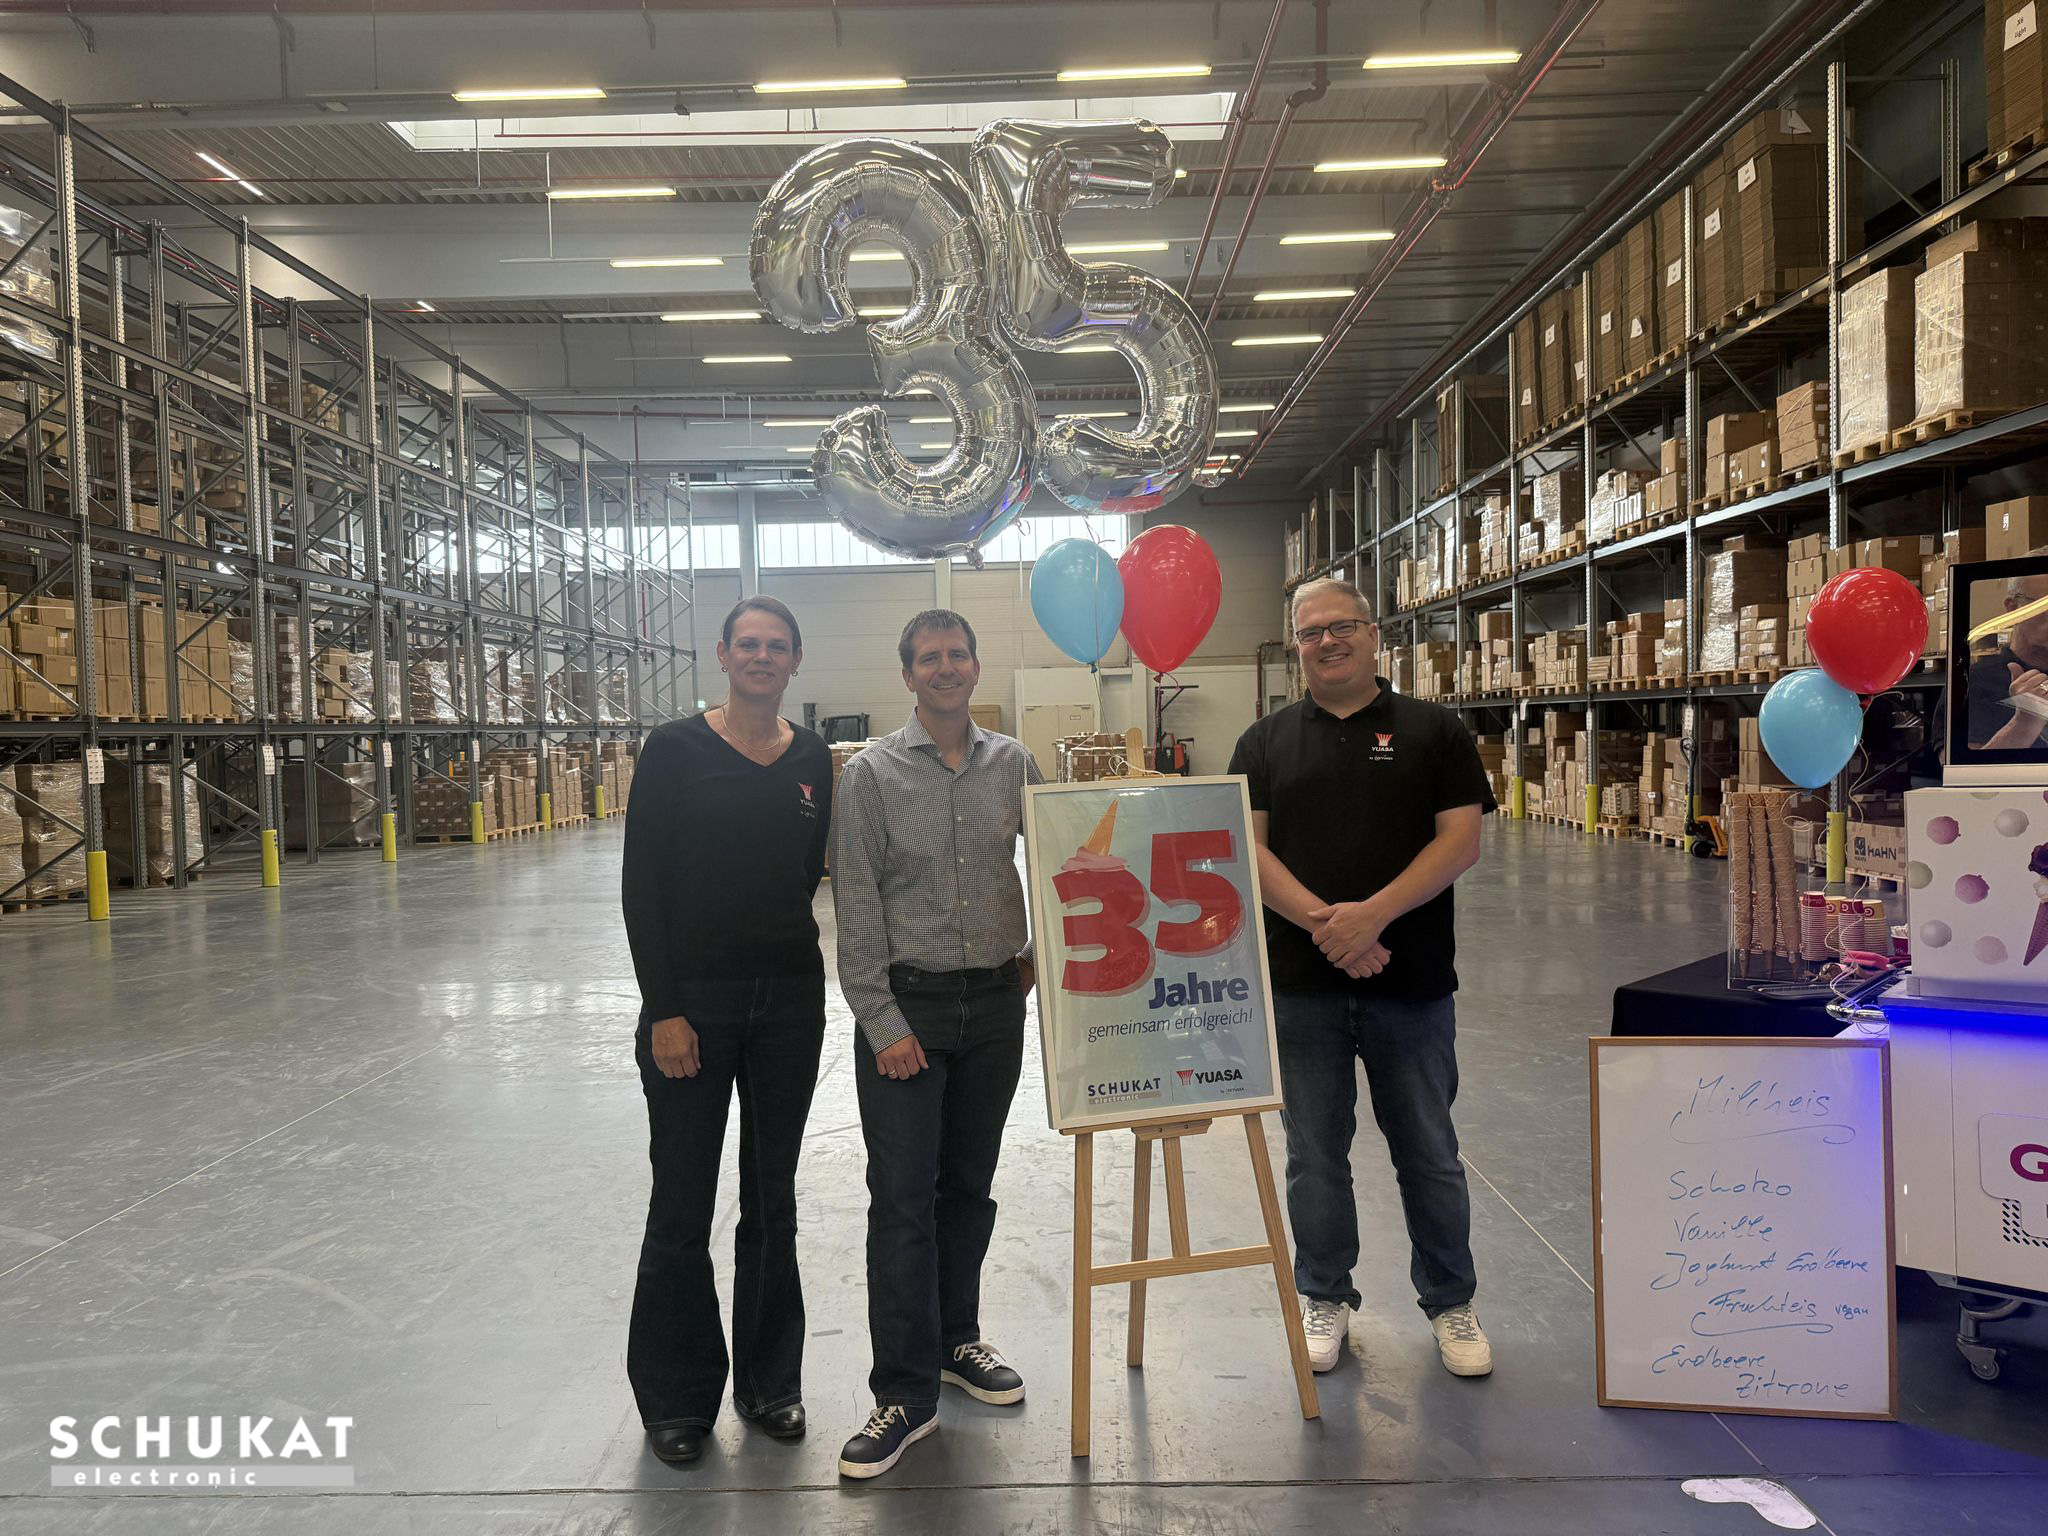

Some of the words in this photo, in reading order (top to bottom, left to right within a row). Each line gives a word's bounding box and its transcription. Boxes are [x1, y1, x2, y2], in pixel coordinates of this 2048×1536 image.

[1867, 844, 1897, 860] HAHN
[1052, 829, 1247, 998] 35
[1149, 971, 1249, 1010] Jahre
[1087, 1016, 1170, 1043] gemeinsam
[1174, 1007, 1254, 1033] erfolgreich!
[1087, 1077, 1162, 1097] SCHUKAT
[1194, 1068, 1243, 1084] YUASA
[1094, 1093, 1140, 1105] electronic
[1667, 1168, 1792, 1201] Schoko
[1673, 1212, 1774, 1242] Vanille
[1735, 1369, 1850, 1399] Zitrone
